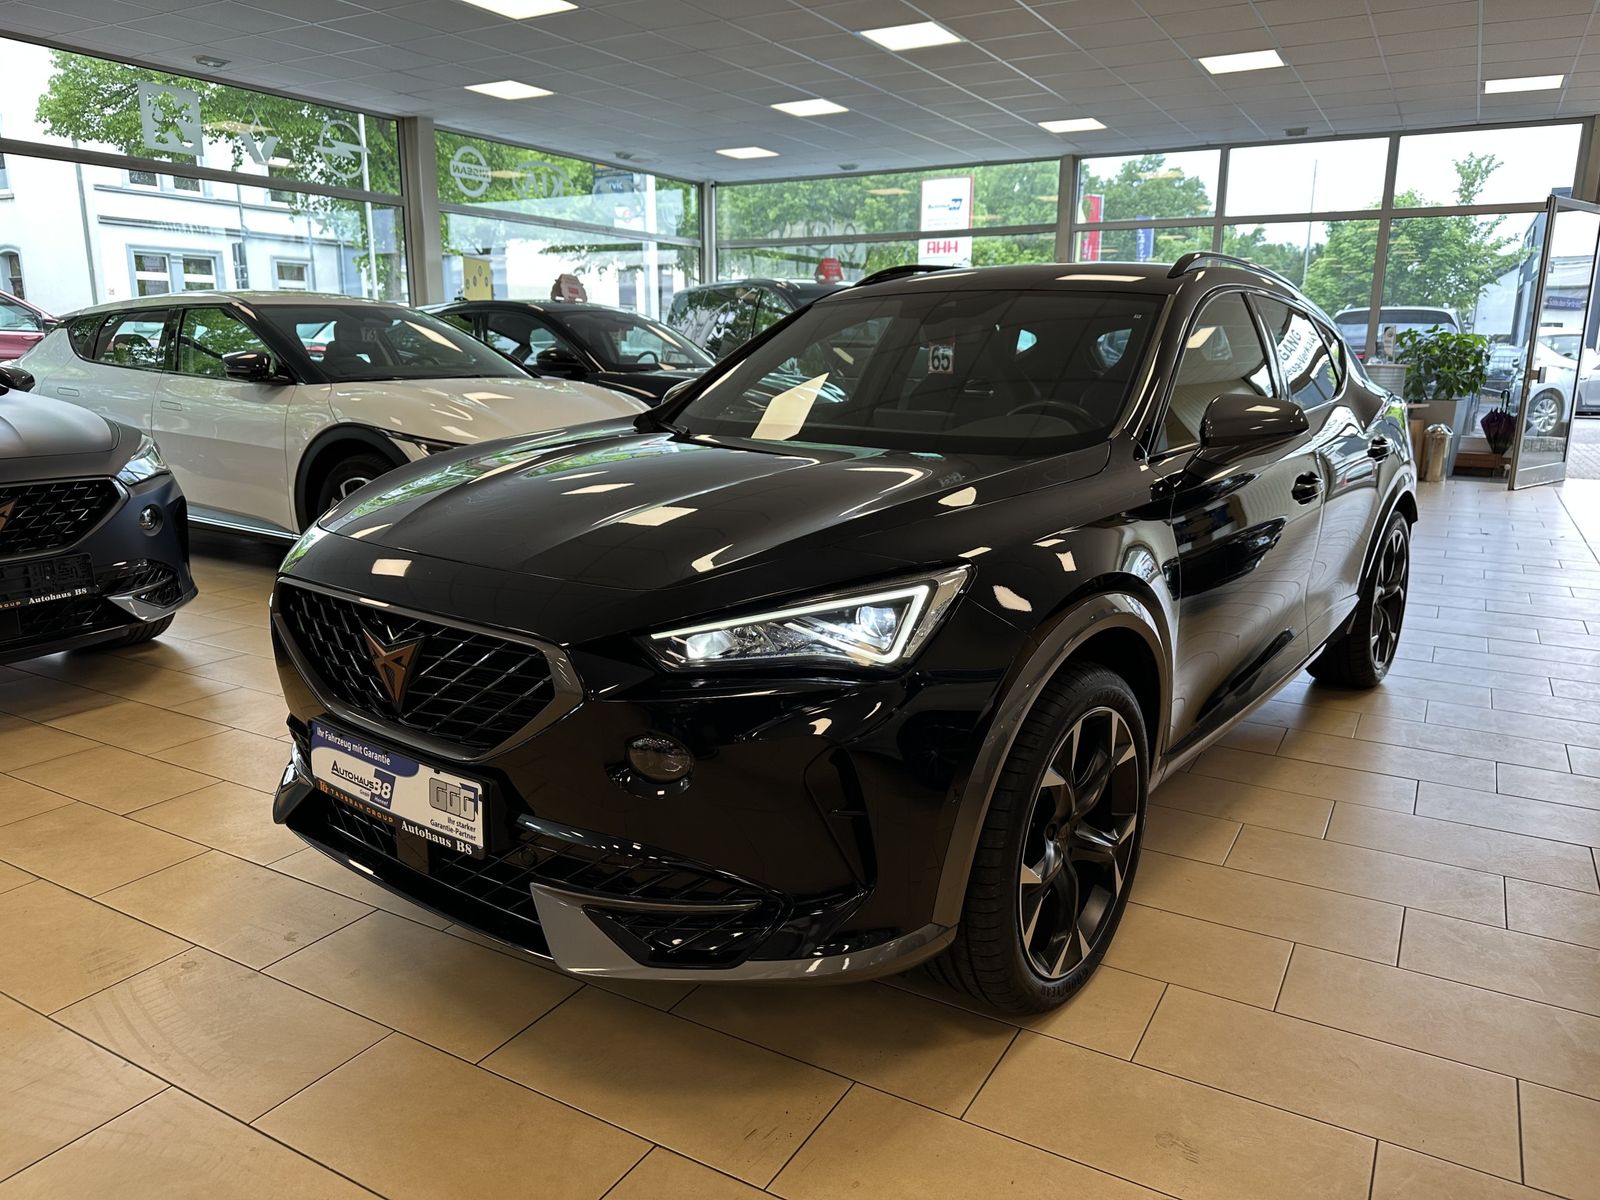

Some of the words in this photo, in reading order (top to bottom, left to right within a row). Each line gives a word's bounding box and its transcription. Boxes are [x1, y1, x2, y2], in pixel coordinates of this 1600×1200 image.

[931, 346, 951, 371] 65
[28, 592, 72, 604] Autohaus
[75, 588, 87, 596] B8
[316, 726, 325, 738] Ihr
[324, 730, 353, 752] Fahrzeug
[352, 743, 363, 754] mit
[363, 746, 391, 766] Garantie
[401, 820, 452, 848] Autohaus
[456, 840, 473, 855] B8
[430, 819, 476, 841] Garantie-Partner
[456, 820, 477, 833] starker
